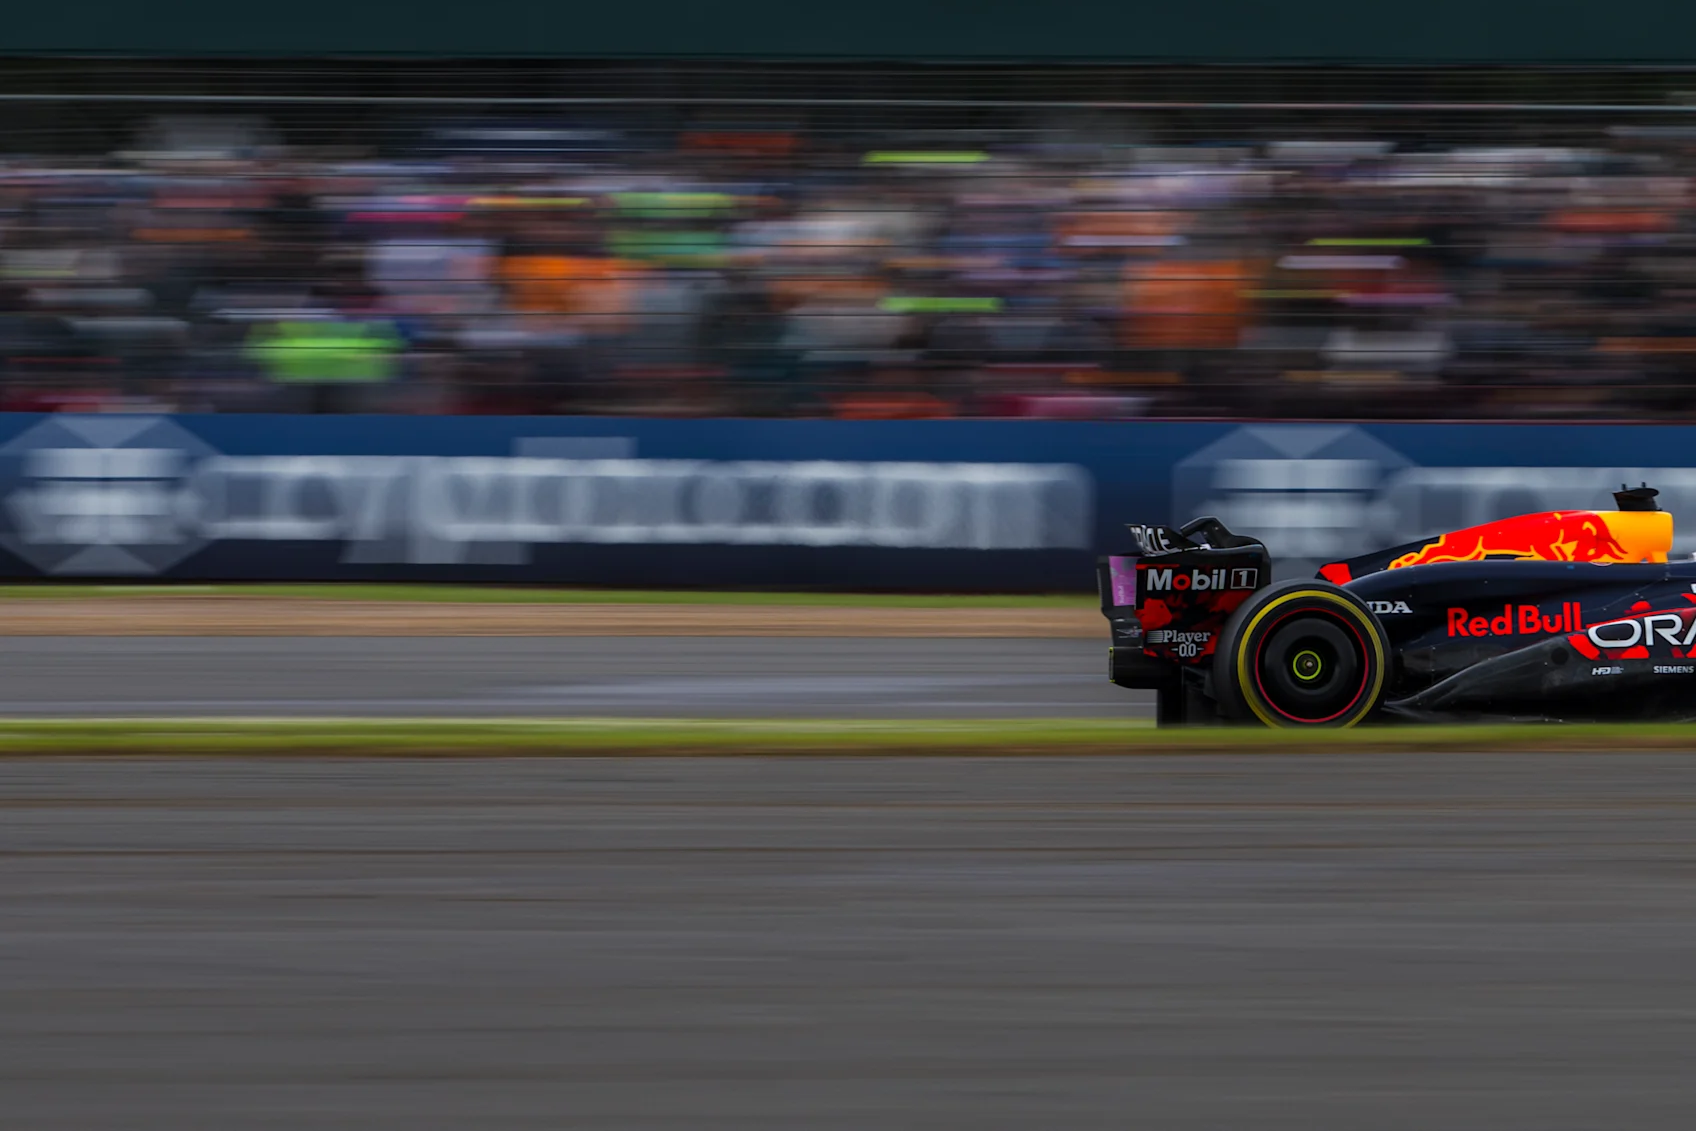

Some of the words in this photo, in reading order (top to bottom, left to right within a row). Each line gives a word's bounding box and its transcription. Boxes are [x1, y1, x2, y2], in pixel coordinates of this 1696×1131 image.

[1146, 569, 1226, 590] Mobil
[1447, 603, 1513, 637] Red
[1517, 601, 1583, 634] Bull
[1163, 629, 1211, 645] Player
[1653, 665, 1695, 674] SIEMENS
